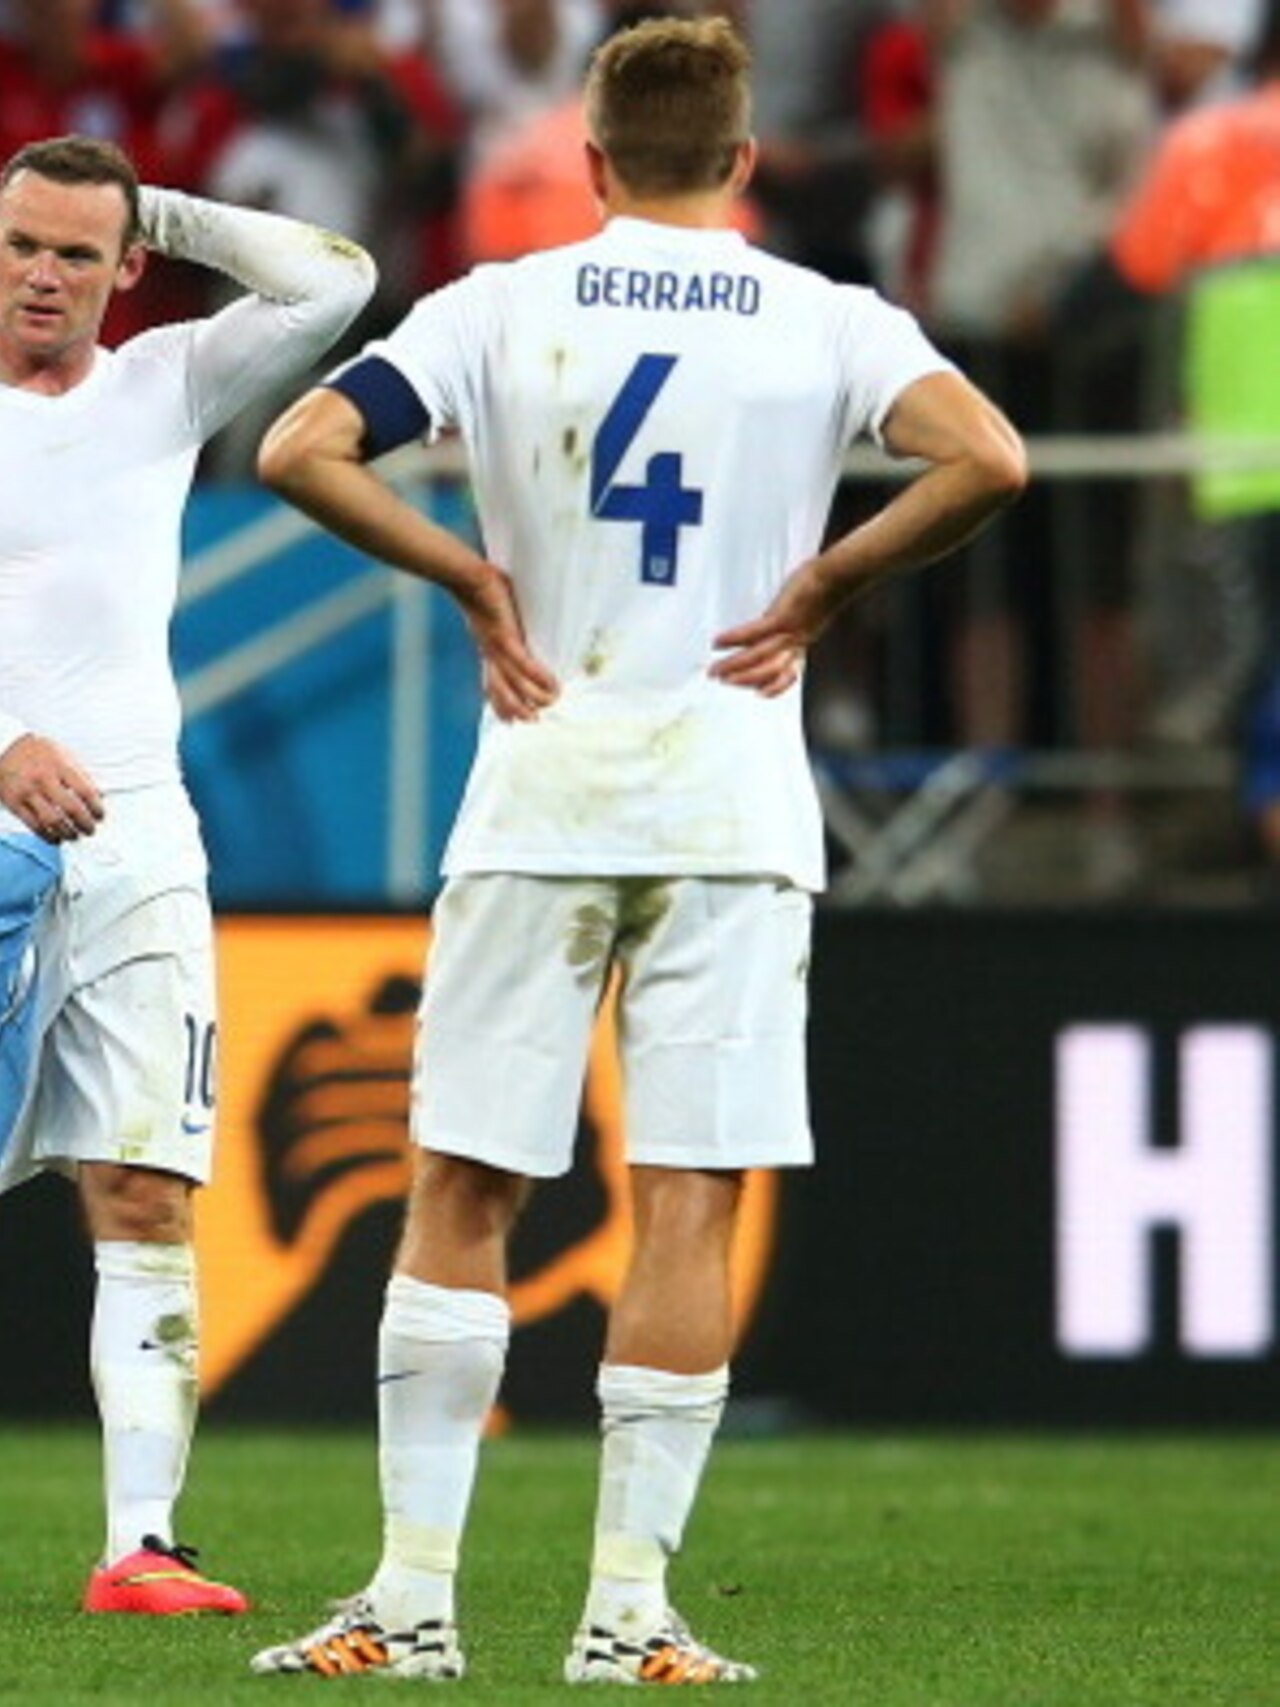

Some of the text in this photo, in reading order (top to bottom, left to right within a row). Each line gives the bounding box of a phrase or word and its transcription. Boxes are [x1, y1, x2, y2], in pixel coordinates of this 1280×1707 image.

[576, 263, 761, 316] GERRARD
[589, 353, 703, 586] 4
[1055, 1025, 1274, 1358] H
